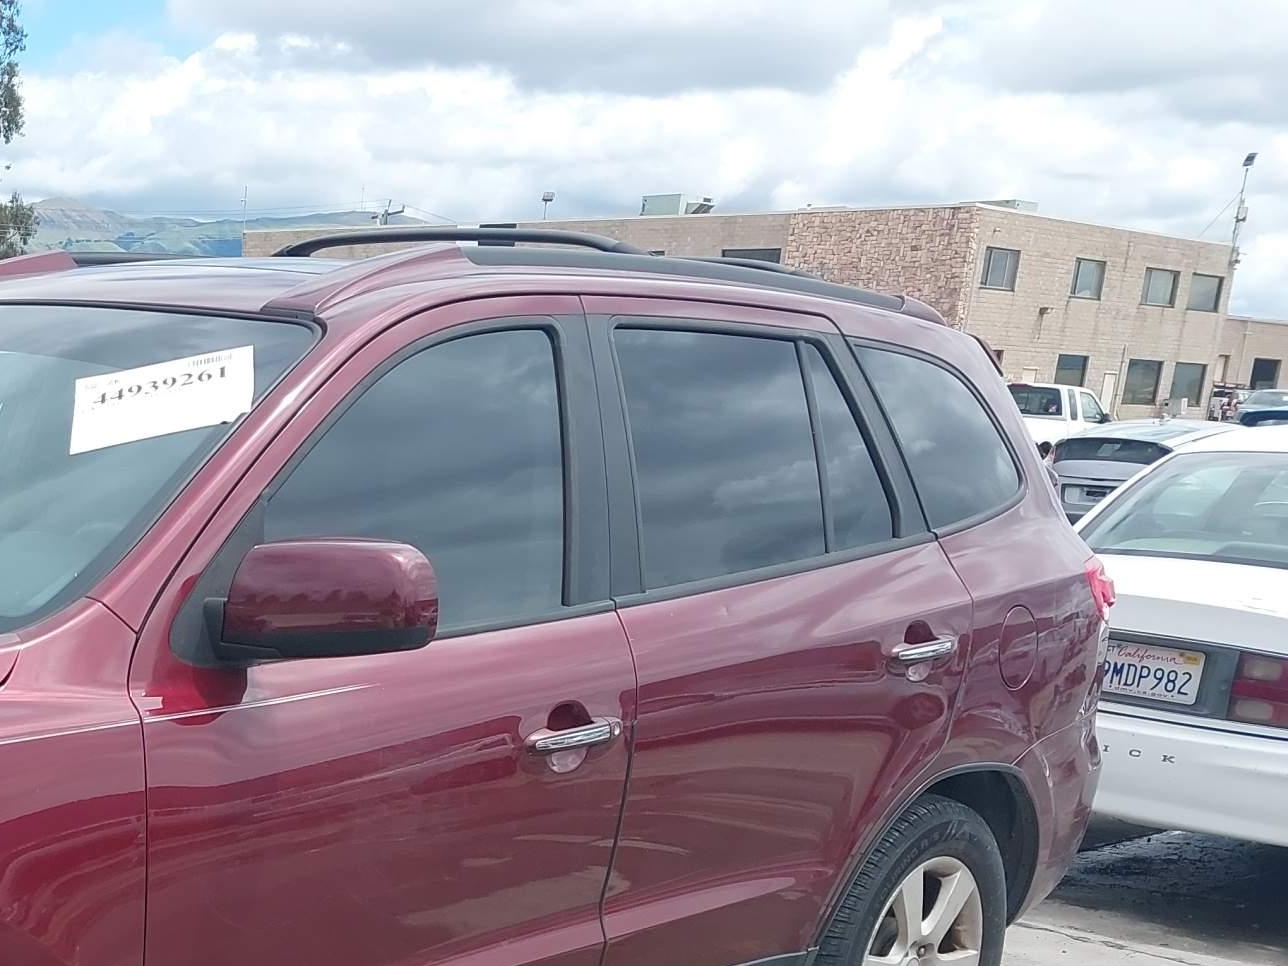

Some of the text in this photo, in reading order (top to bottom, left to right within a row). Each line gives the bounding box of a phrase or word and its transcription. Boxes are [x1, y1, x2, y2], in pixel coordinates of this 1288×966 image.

[93, 366, 227, 405] 44939261
[1117, 645, 1183, 665] California
[1103, 660, 1192, 696] 9MDP982
[1101, 744, 1176, 764] ICK
